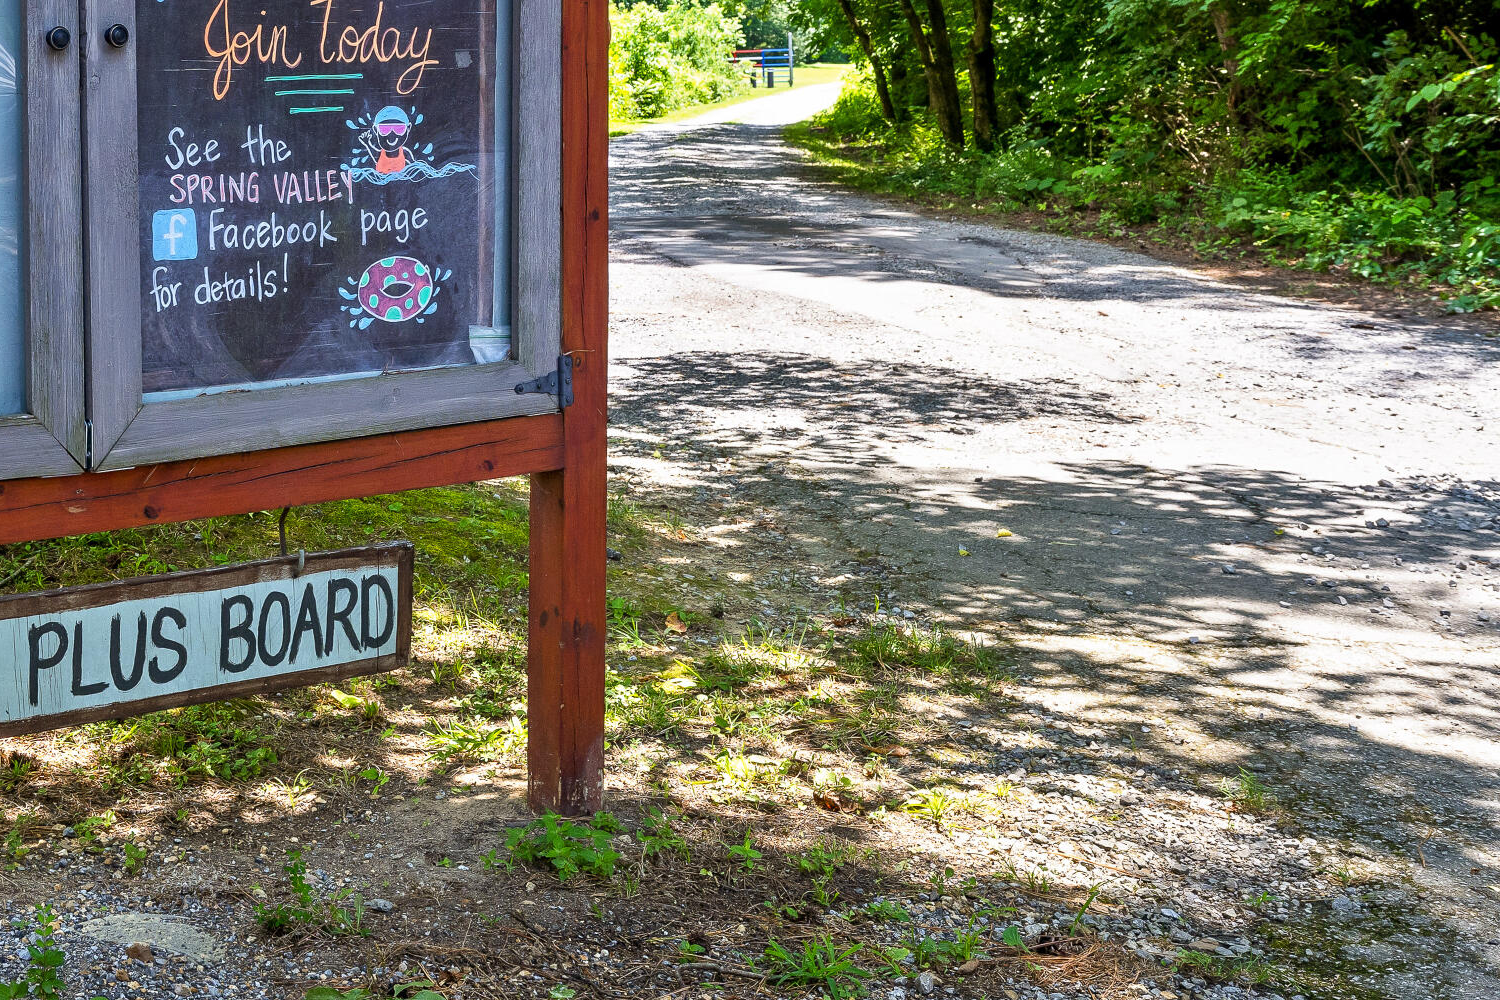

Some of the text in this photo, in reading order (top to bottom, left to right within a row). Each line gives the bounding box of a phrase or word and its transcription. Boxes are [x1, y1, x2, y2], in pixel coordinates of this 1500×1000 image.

[166, 124, 292, 170] See the
[170, 169, 354, 204] SPRING VALLEY
[209, 208, 338, 251] Facebook
[360, 207, 429, 246] page
[150, 253, 289, 312] for details!
[29, 606, 188, 706] PLUS
[220, 573, 395, 673] BOARD
